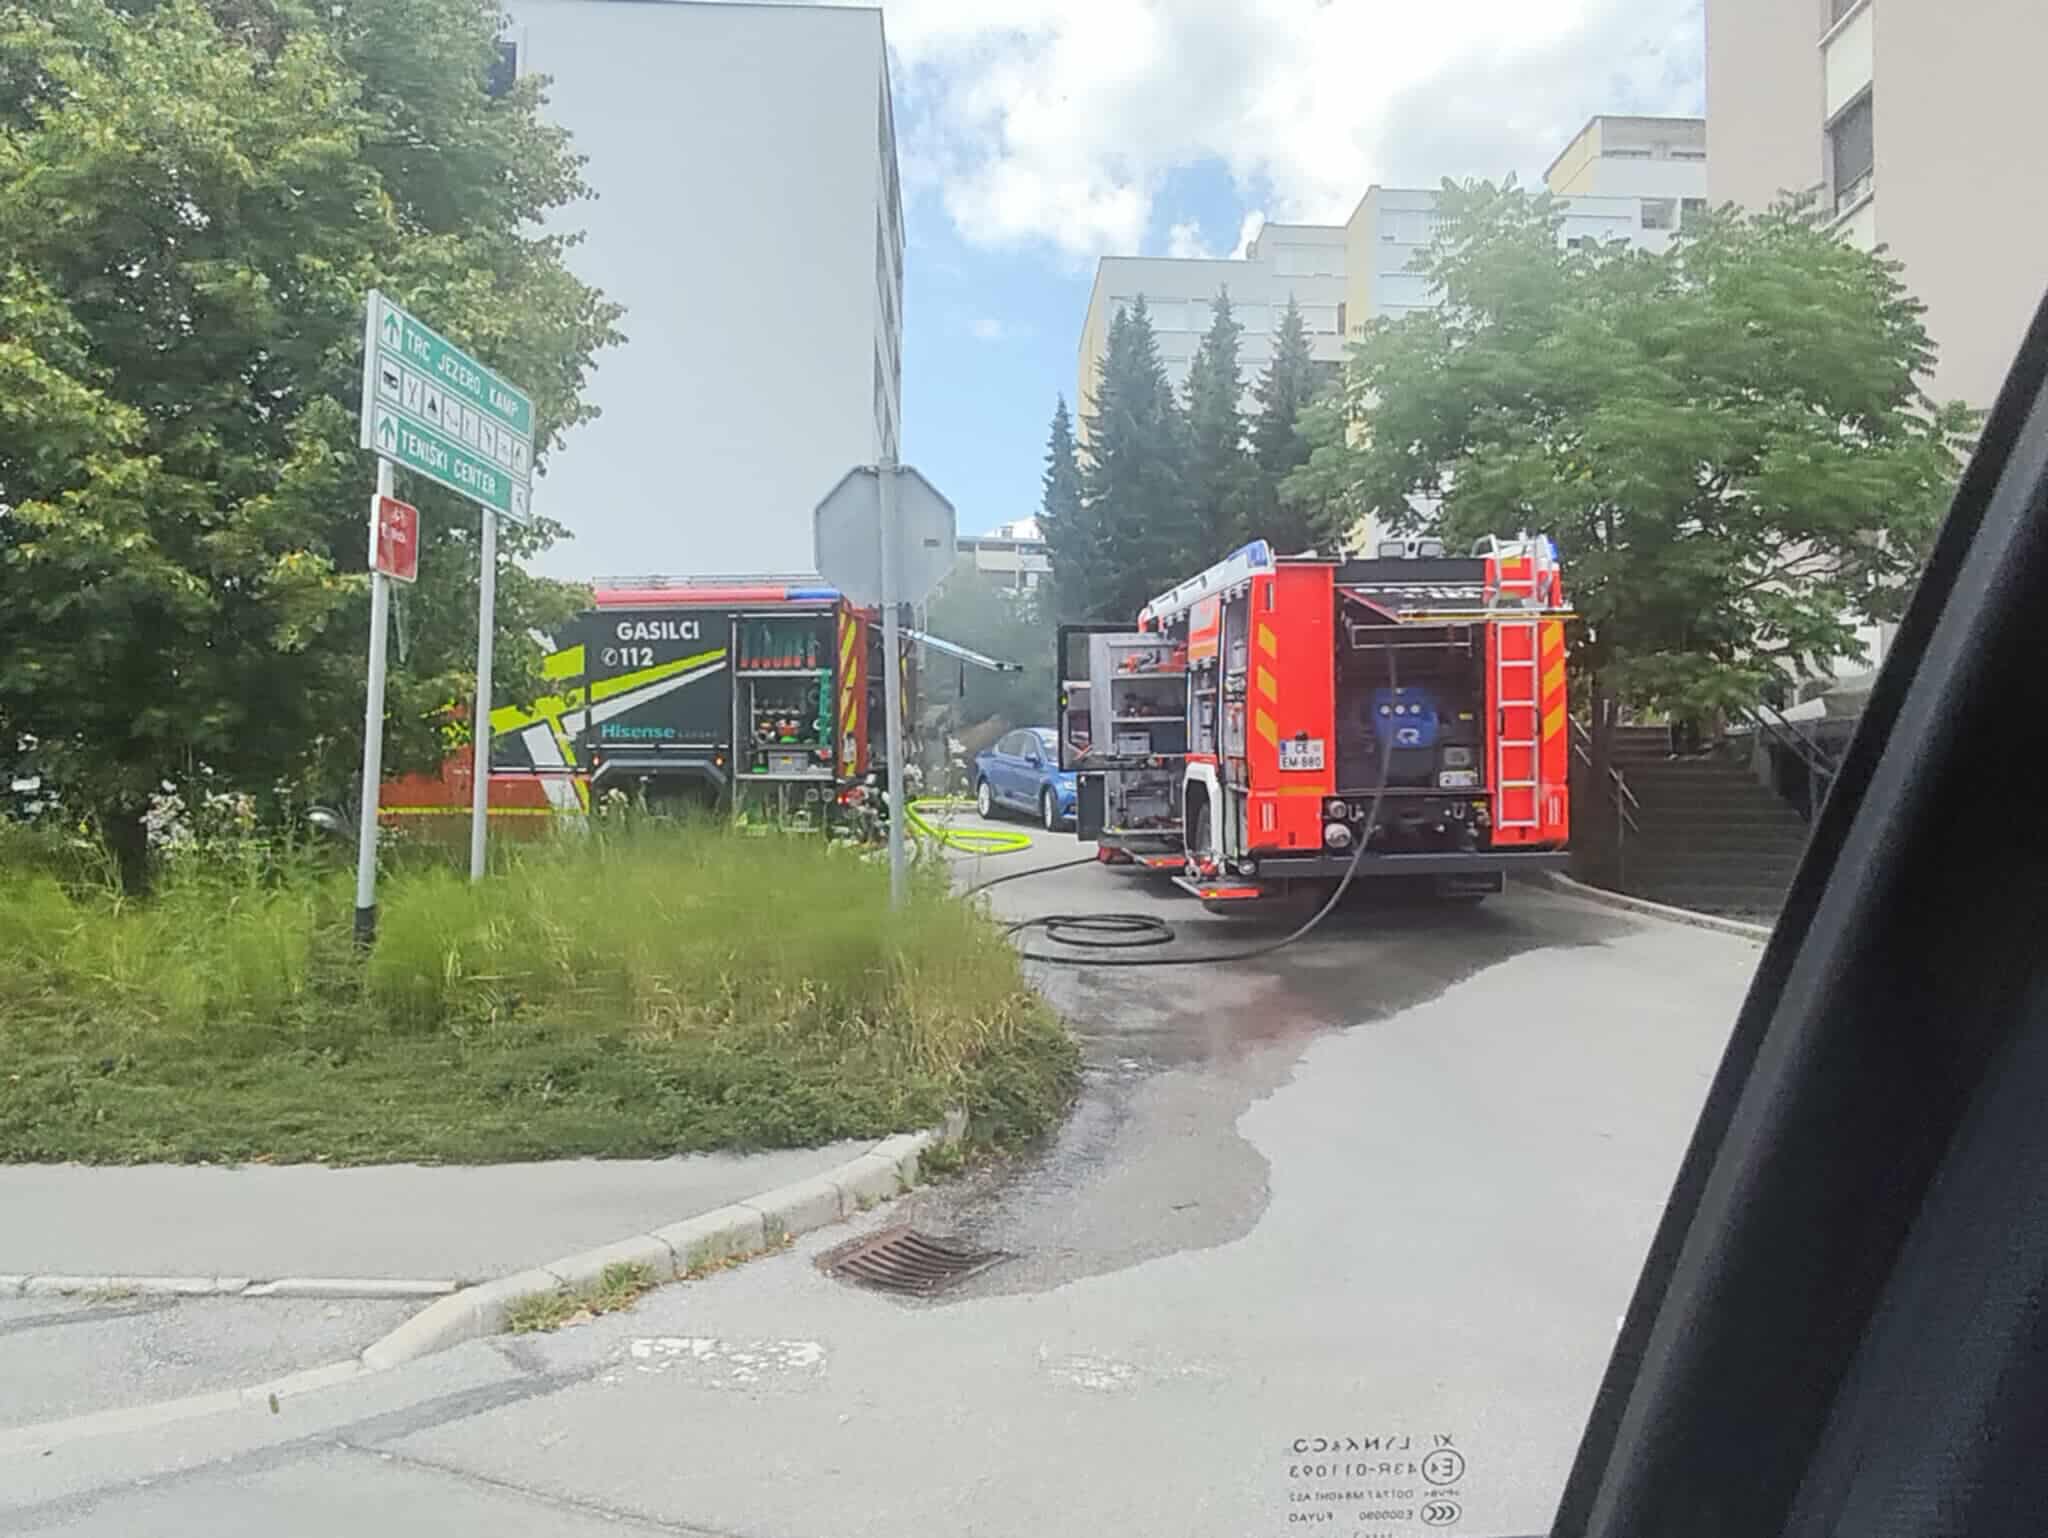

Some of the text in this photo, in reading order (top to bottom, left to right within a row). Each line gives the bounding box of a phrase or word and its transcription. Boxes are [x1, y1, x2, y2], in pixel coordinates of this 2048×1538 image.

[401, 429, 495, 497] TENIŠKI CENTER
[616, 621, 700, 640] GASILCI
[619, 647, 654, 667] 112
[601, 723, 674, 738] Hisense
[1295, 743, 1308, 754] CE
